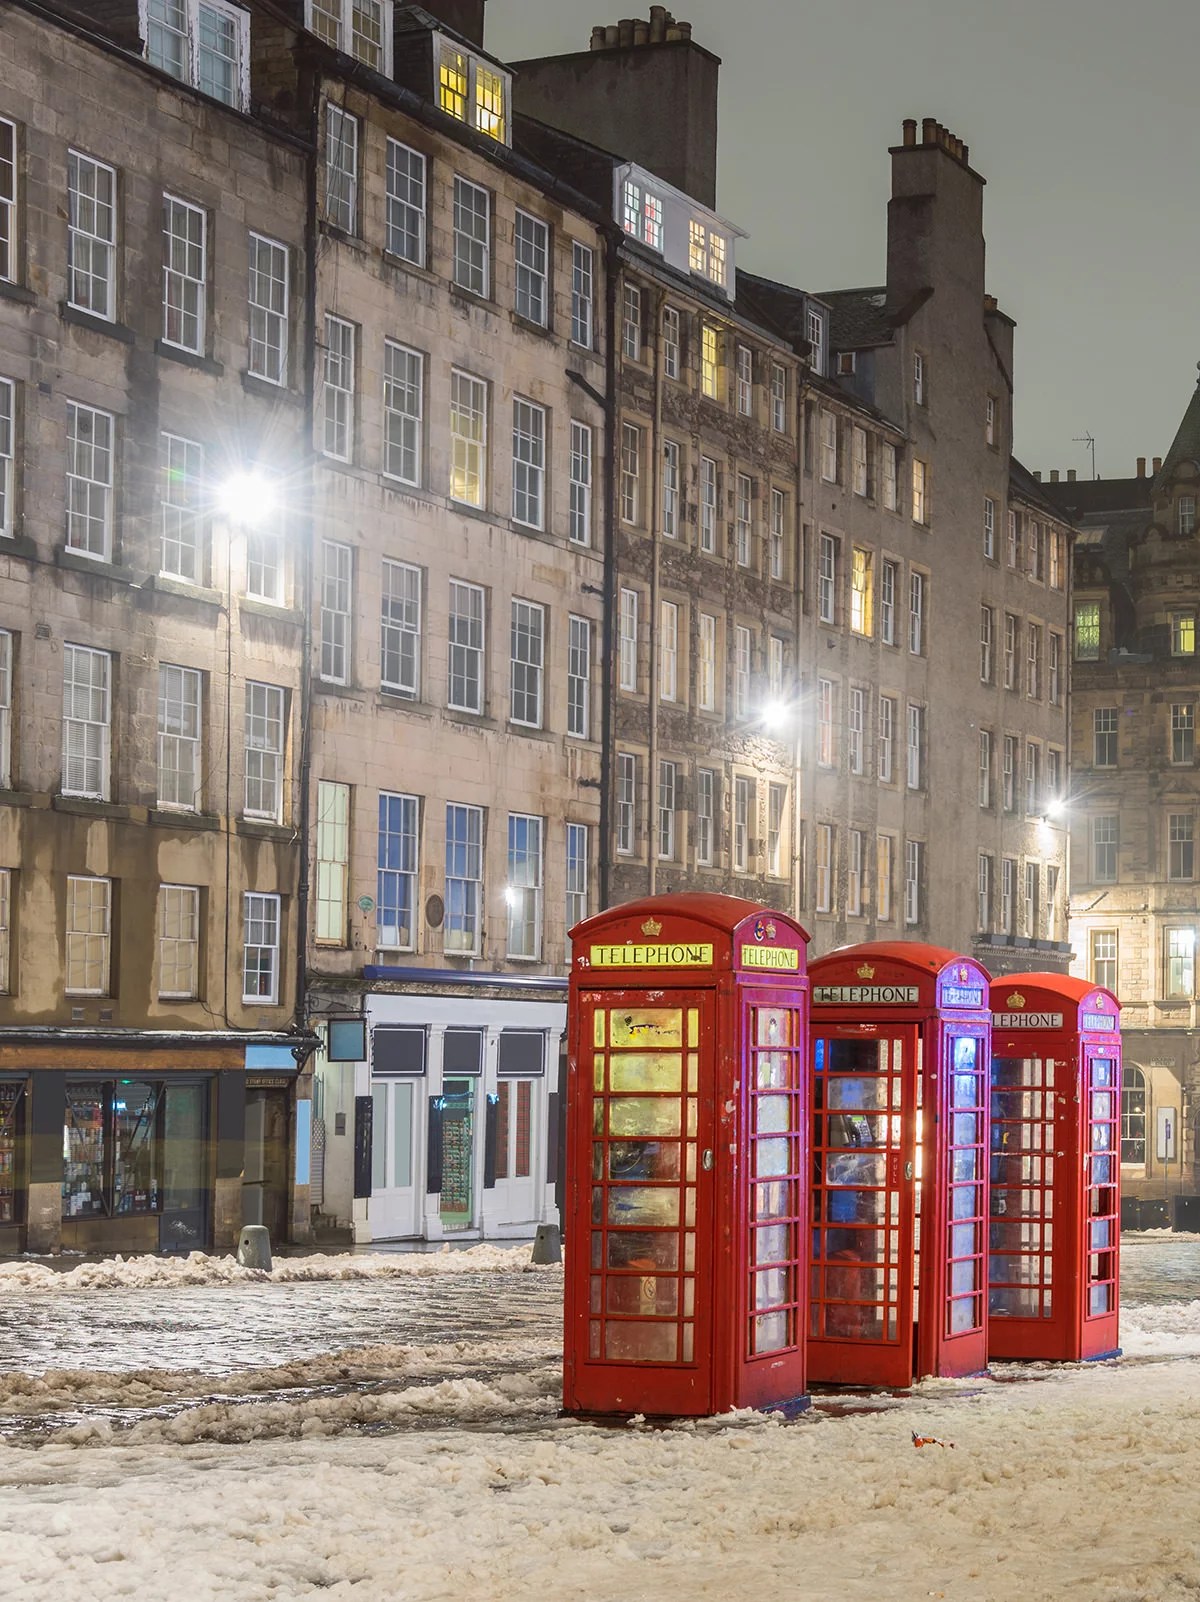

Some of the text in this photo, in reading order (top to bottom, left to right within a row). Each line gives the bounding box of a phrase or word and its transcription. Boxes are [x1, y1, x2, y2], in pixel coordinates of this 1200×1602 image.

[597, 946, 709, 964] TELEPHONE
[743, 947, 795, 968] TELEPHONE
[818, 987, 915, 1002] TELEPHONE
[992, 1014, 1059, 1027] LEPHONE
